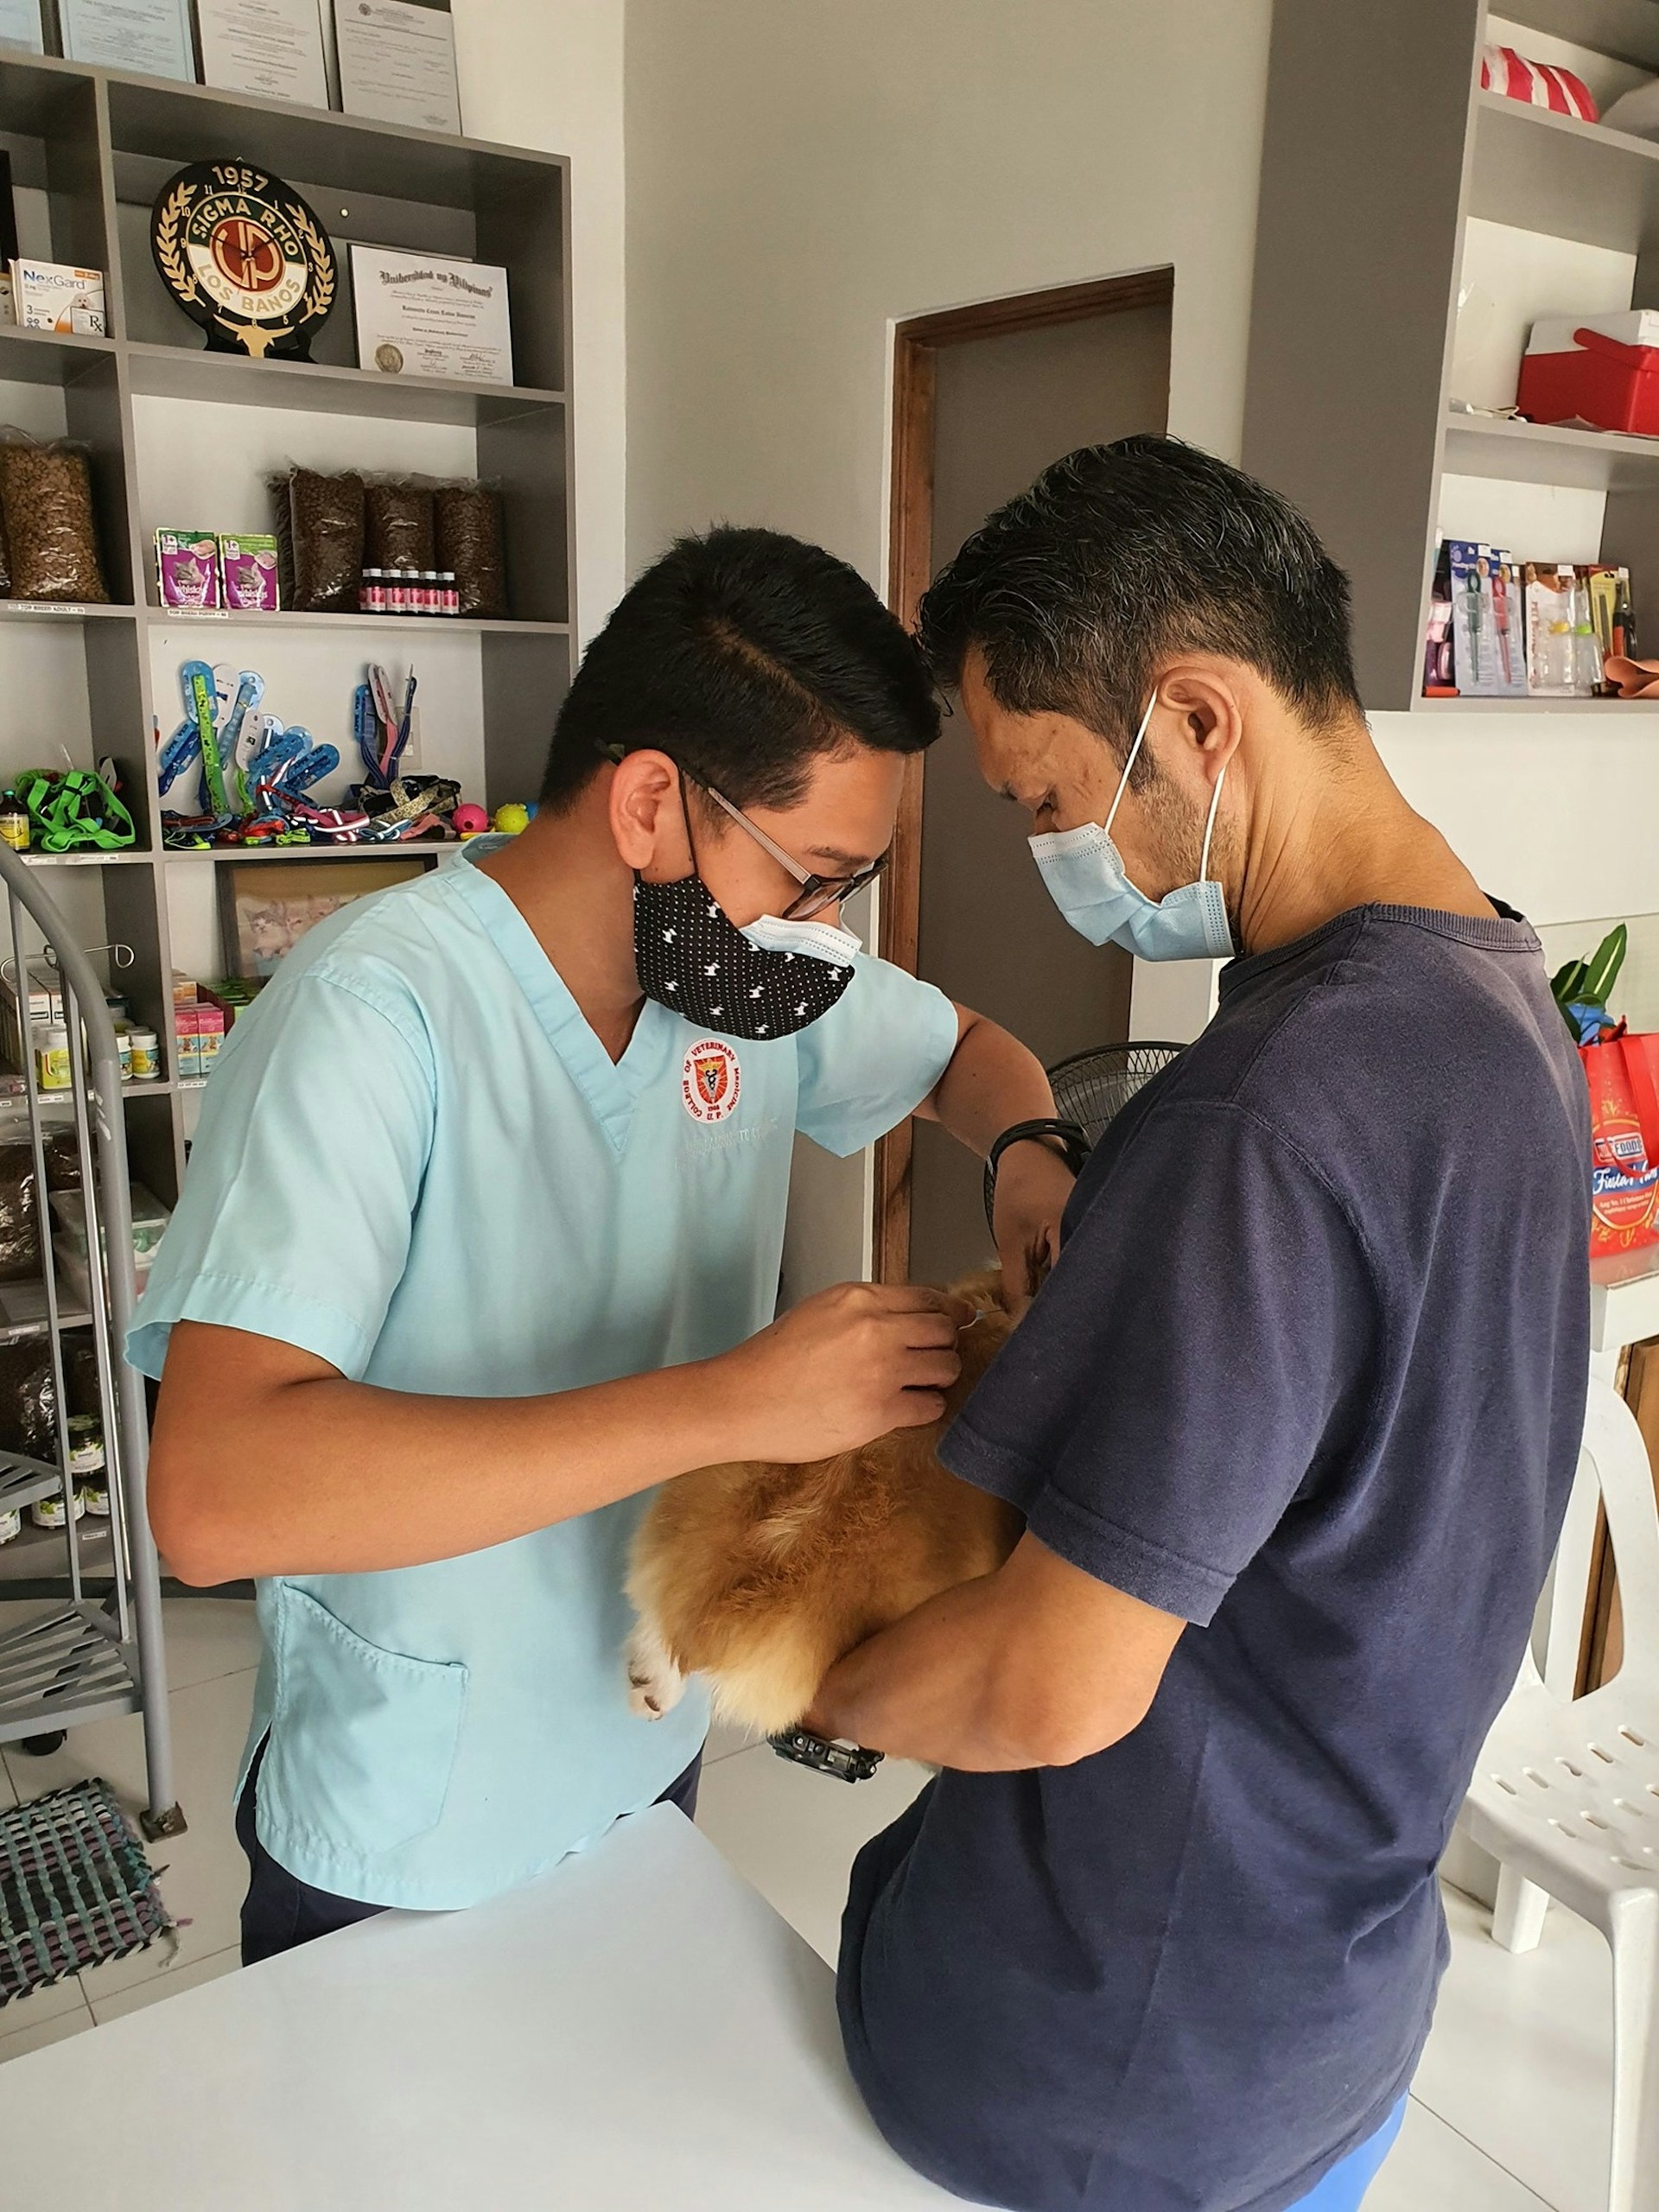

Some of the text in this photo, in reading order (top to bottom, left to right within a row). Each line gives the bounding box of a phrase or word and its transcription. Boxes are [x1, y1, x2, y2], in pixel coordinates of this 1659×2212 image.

[204, 184, 213, 195] 11
[212, 166, 269, 192] 1957
[181, 206, 191, 218] 10
[192, 198, 299, 256] SIGMA RHO
[23, 270, 86, 290] NexGard
[198, 264, 234, 302] LOS
[26, 304, 33, 315] 3
[683, 1042, 740, 1116] COLLEGE OF VETERINARY MEDICINE
